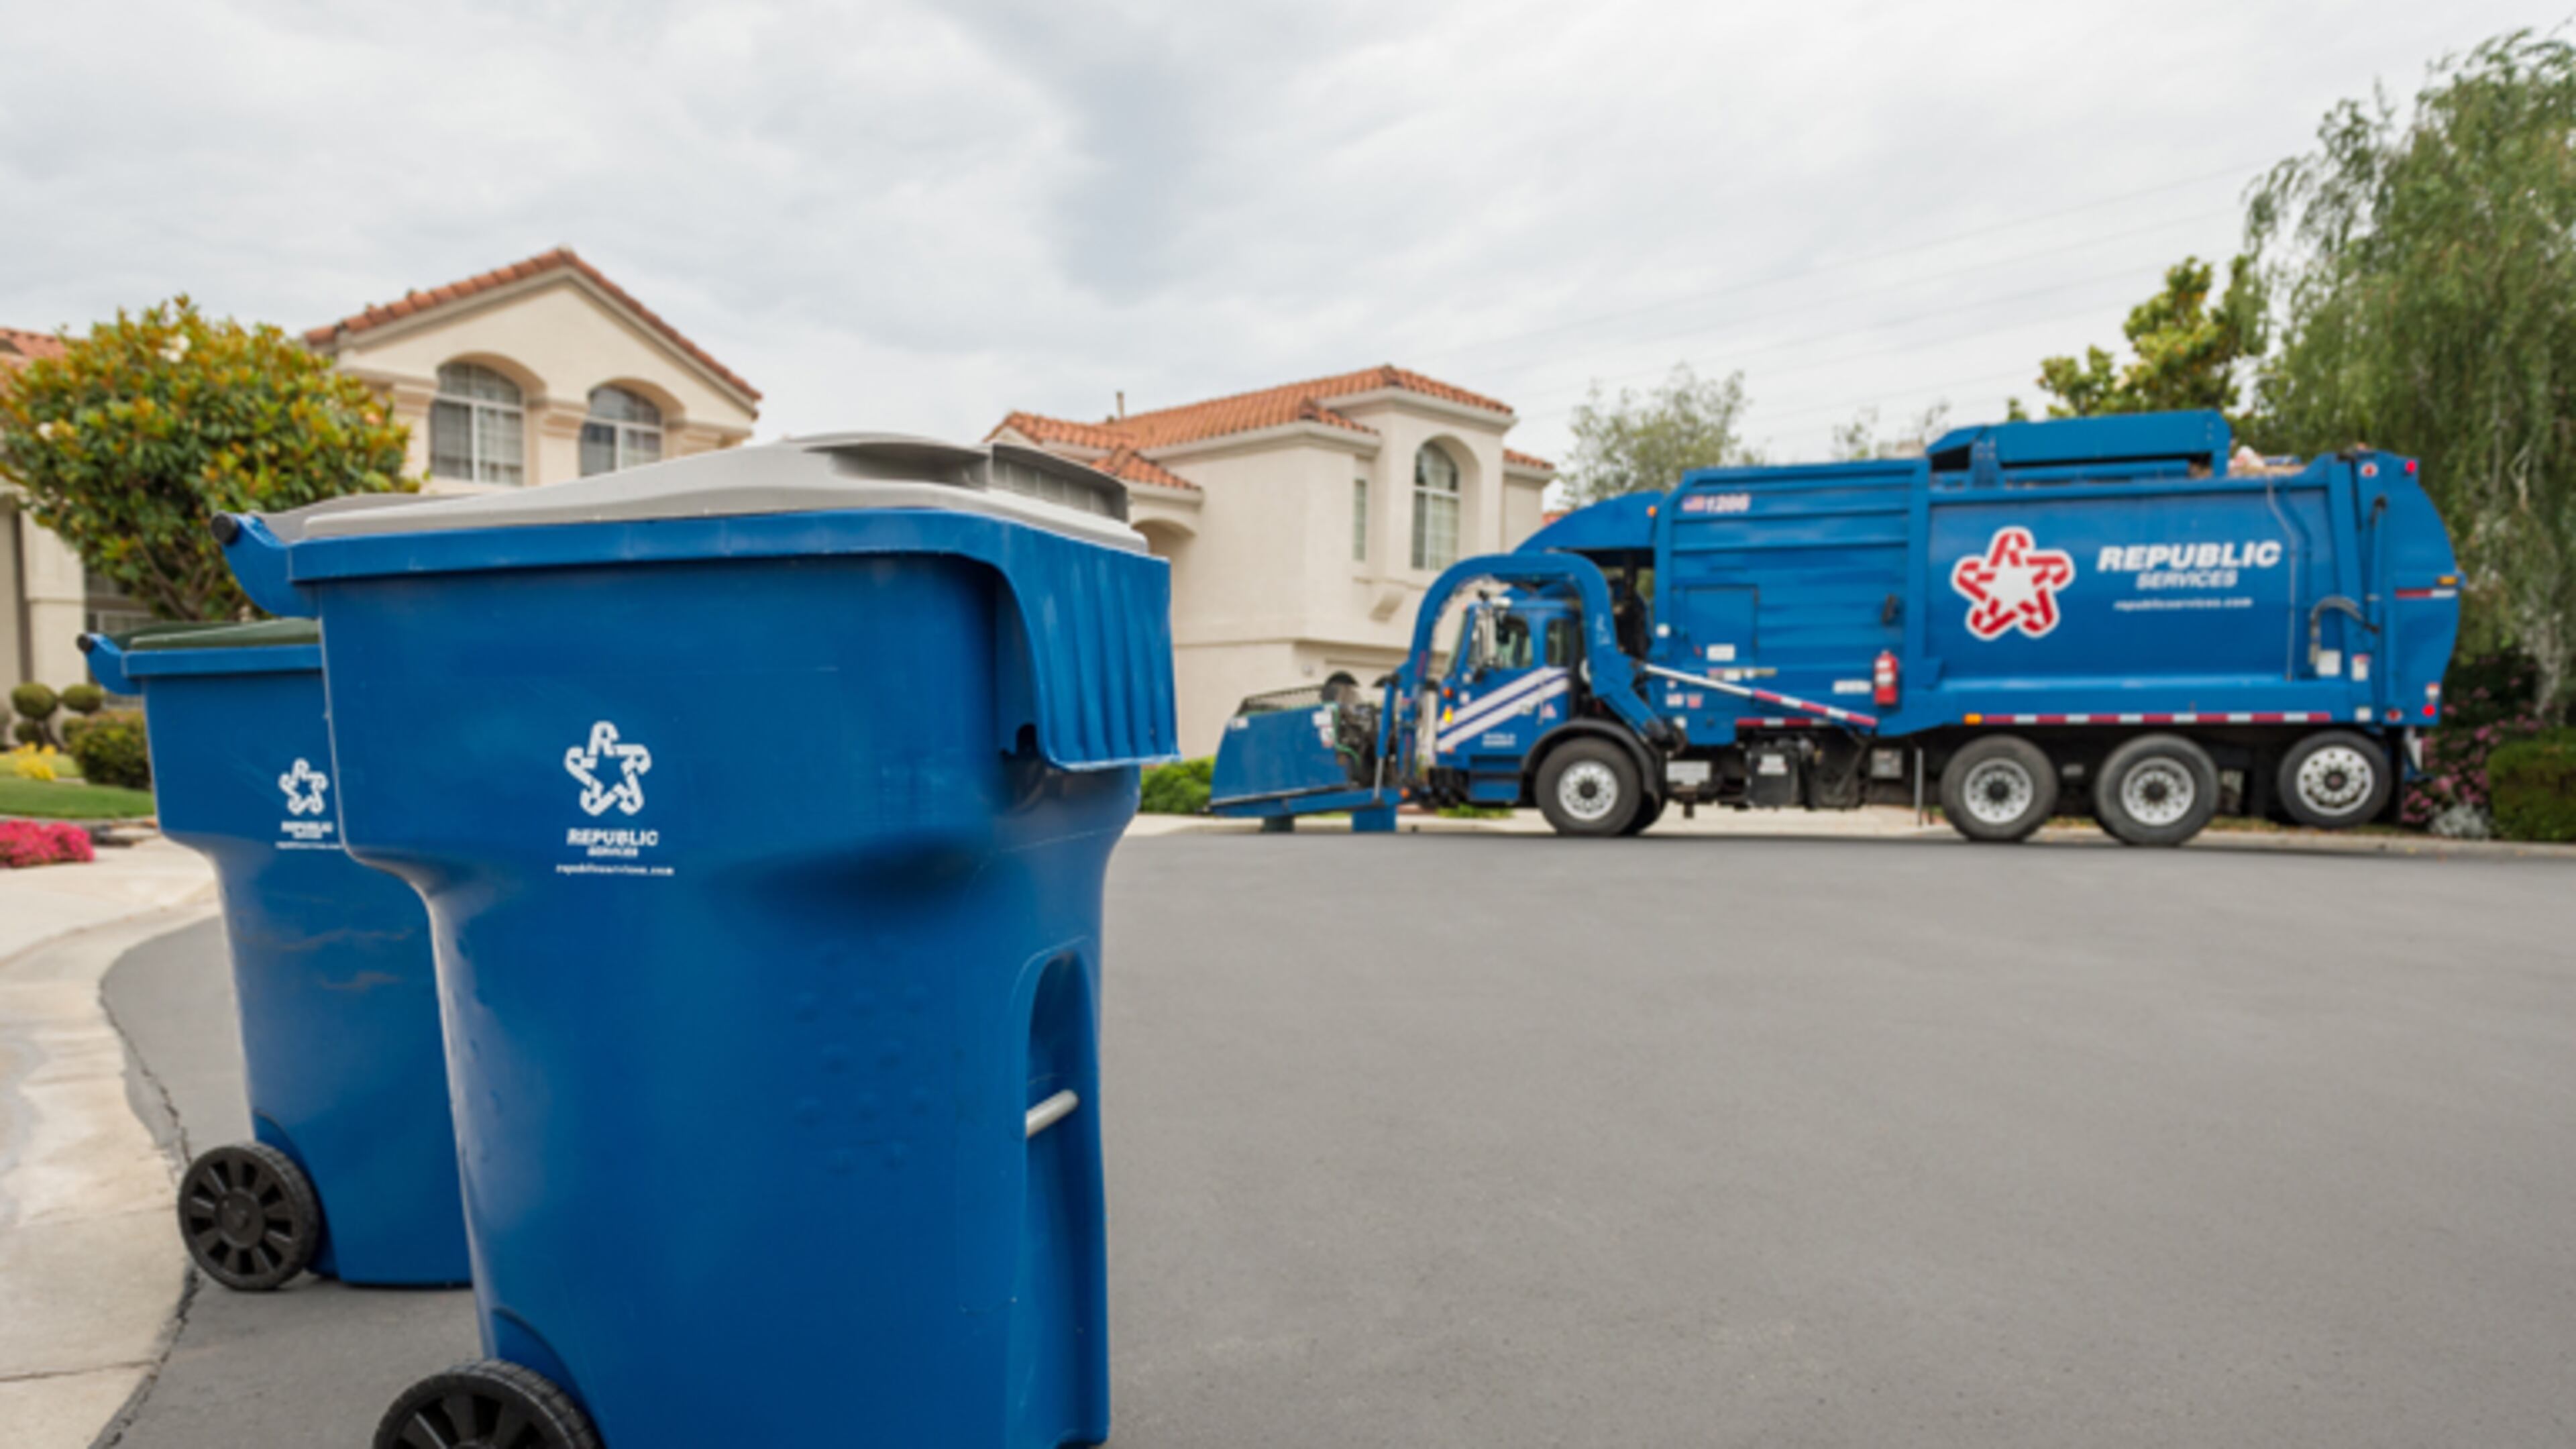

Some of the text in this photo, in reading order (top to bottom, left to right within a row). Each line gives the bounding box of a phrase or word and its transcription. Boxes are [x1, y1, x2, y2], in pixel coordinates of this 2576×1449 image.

[2098, 540, 2282, 571] REPUBLIC
[2136, 570, 2239, 589] SERVICES
[567, 828, 659, 847] REPUBLIC
